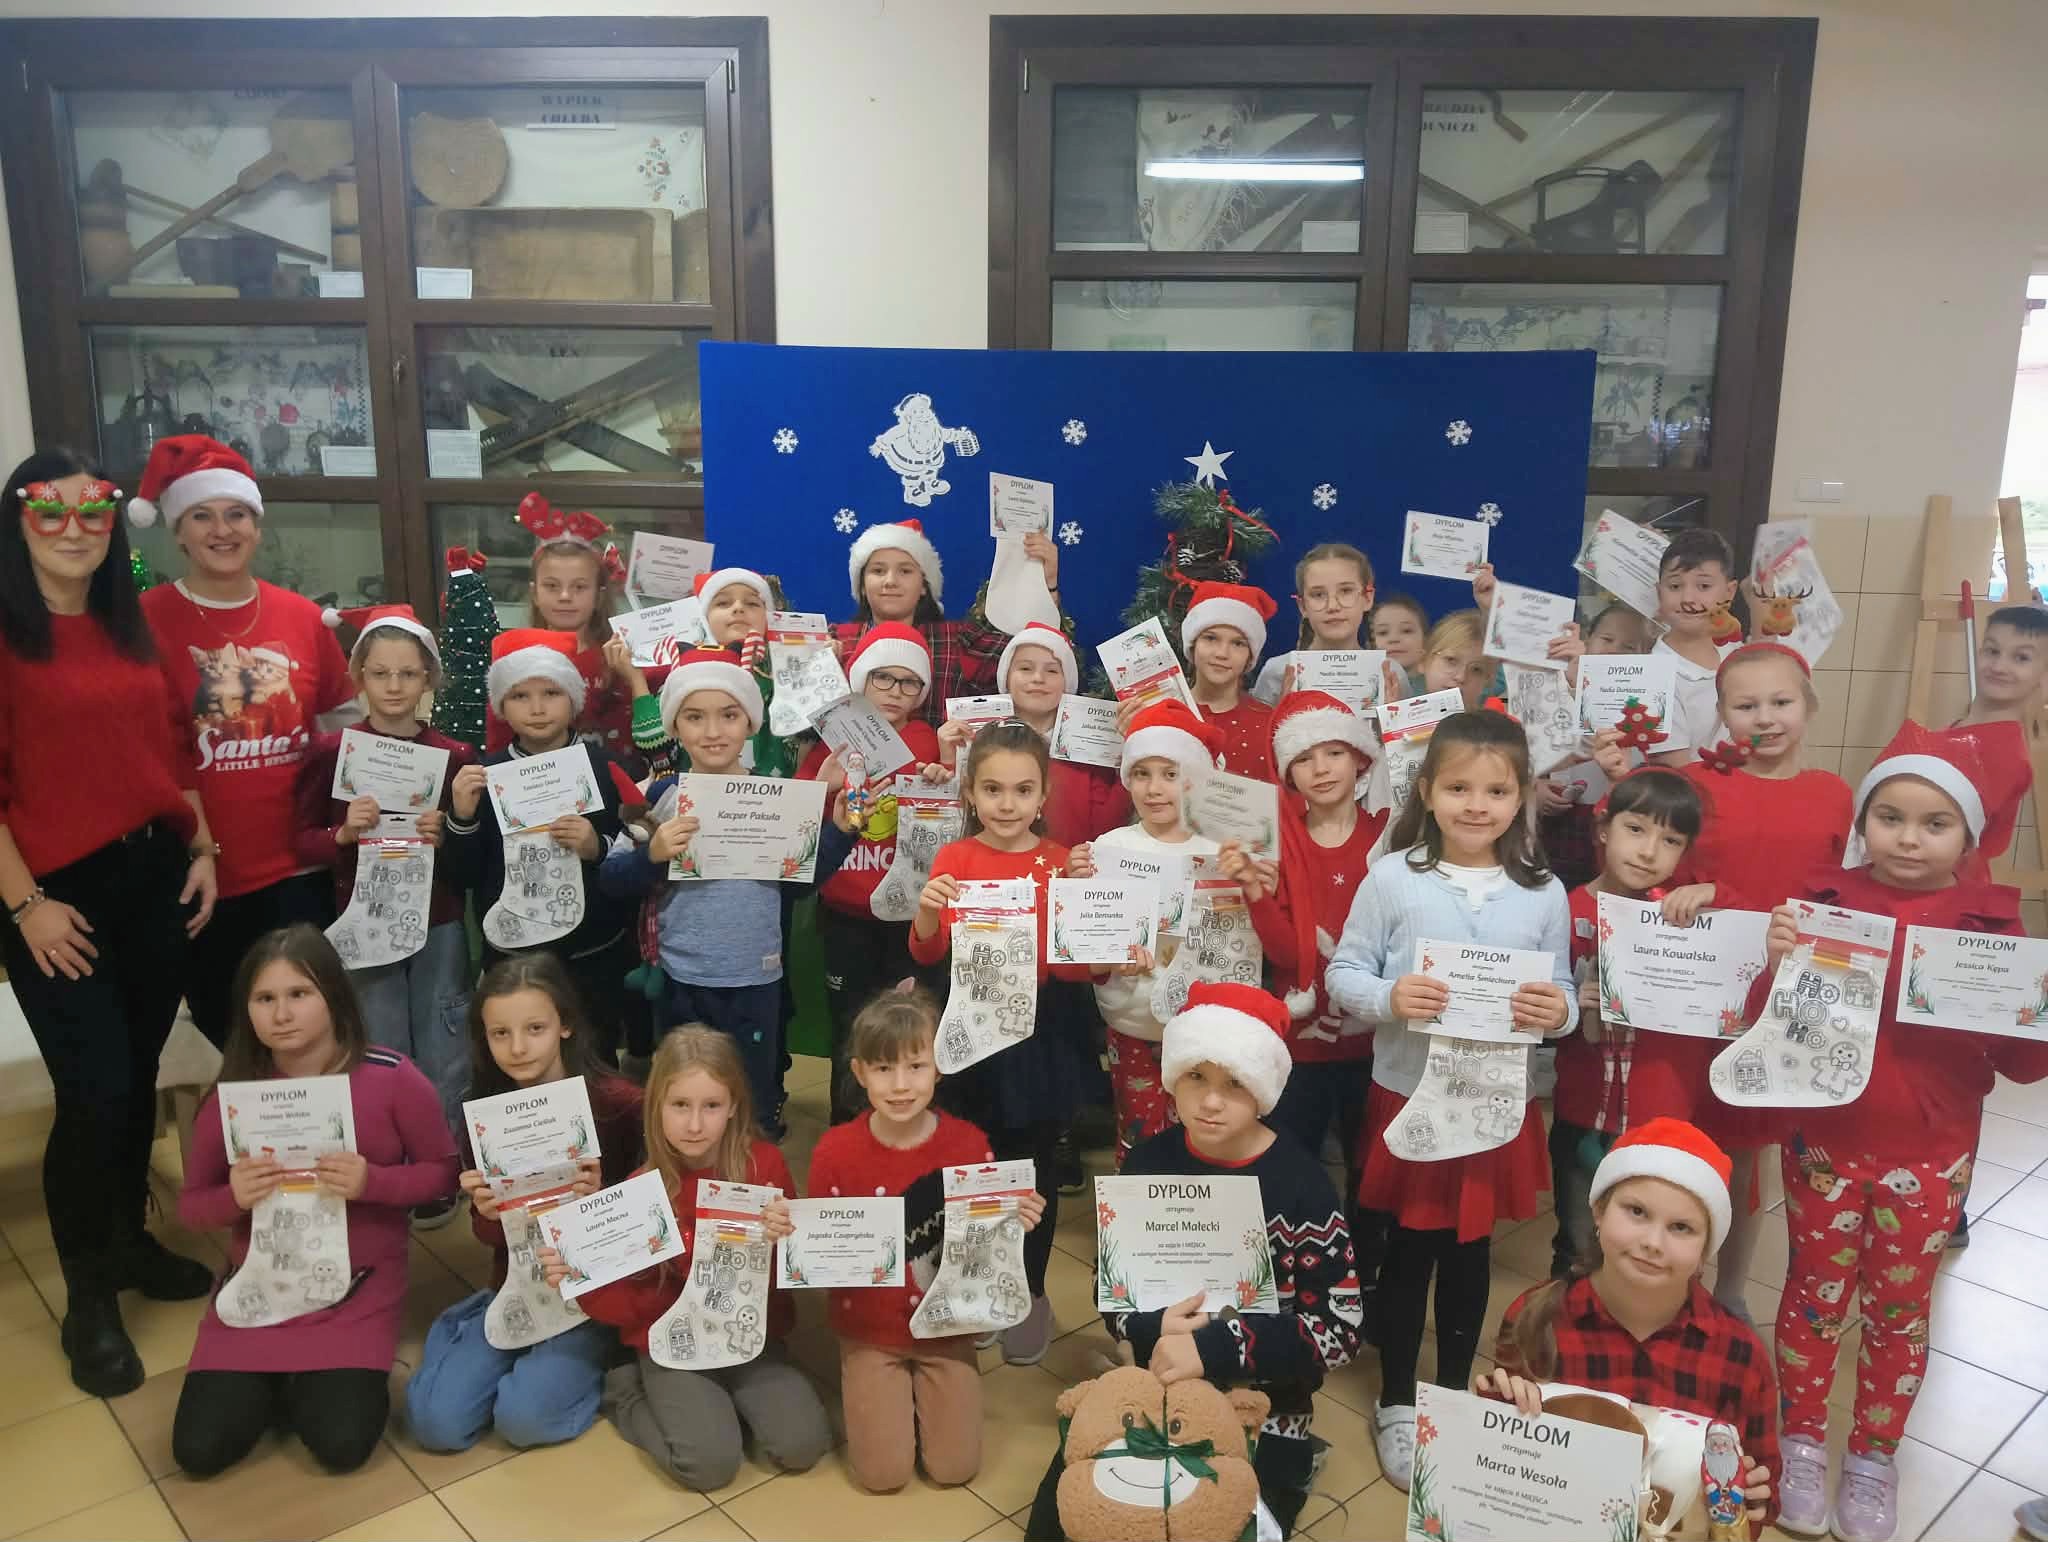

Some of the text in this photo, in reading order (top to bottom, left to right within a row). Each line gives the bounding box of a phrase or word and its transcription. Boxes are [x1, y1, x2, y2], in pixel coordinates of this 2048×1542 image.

[1010, 480, 1034, 490] DYPLOM
[1435, 519, 1465, 528] DYPLOM
[640, 606, 673, 620] DYPLOM
[1322, 654, 1357, 662] DYPLOM
[1607, 665, 1644, 676] DYPLOM
[866, 713, 891, 743] DYPLOM
[376, 740, 415, 755] DYPLOM
[519, 760, 557, 777] DYPLOM
[725, 782, 783, 797] DYPLOM
[717, 810, 781, 822] Kacper Pakuła
[1119, 858, 1161, 874] DYPLOM
[1084, 890, 1124, 901] DYPLOM
[1079, 912, 1094, 920] Julia
[1957, 935, 2017, 952] DYPLOM
[1460, 949, 1511, 964] DYPLOM
[1633, 944, 1717, 963] Laura Kowalska
[1954, 959, 1985, 970] Jessica
[1448, 970, 1475, 981] Amelia
[260, 1089, 307, 1103] DYPLOM
[505, 1096, 549, 1115] DYPLOM
[1148, 1183, 1212, 1200] DYPLOM
[579, 1188, 624, 1214] DYPLOM
[819, 1209, 865, 1220] DYPLOM
[585, 1221, 605, 1233] Laura
[1145, 1220, 1220, 1233] Marcel Małecki
[1483, 1410, 1571, 1449] DYPLOM
[1501, 1442, 1542, 1460] otrzymuje
[1476, 1453, 1568, 1490] Marta Wesoła
